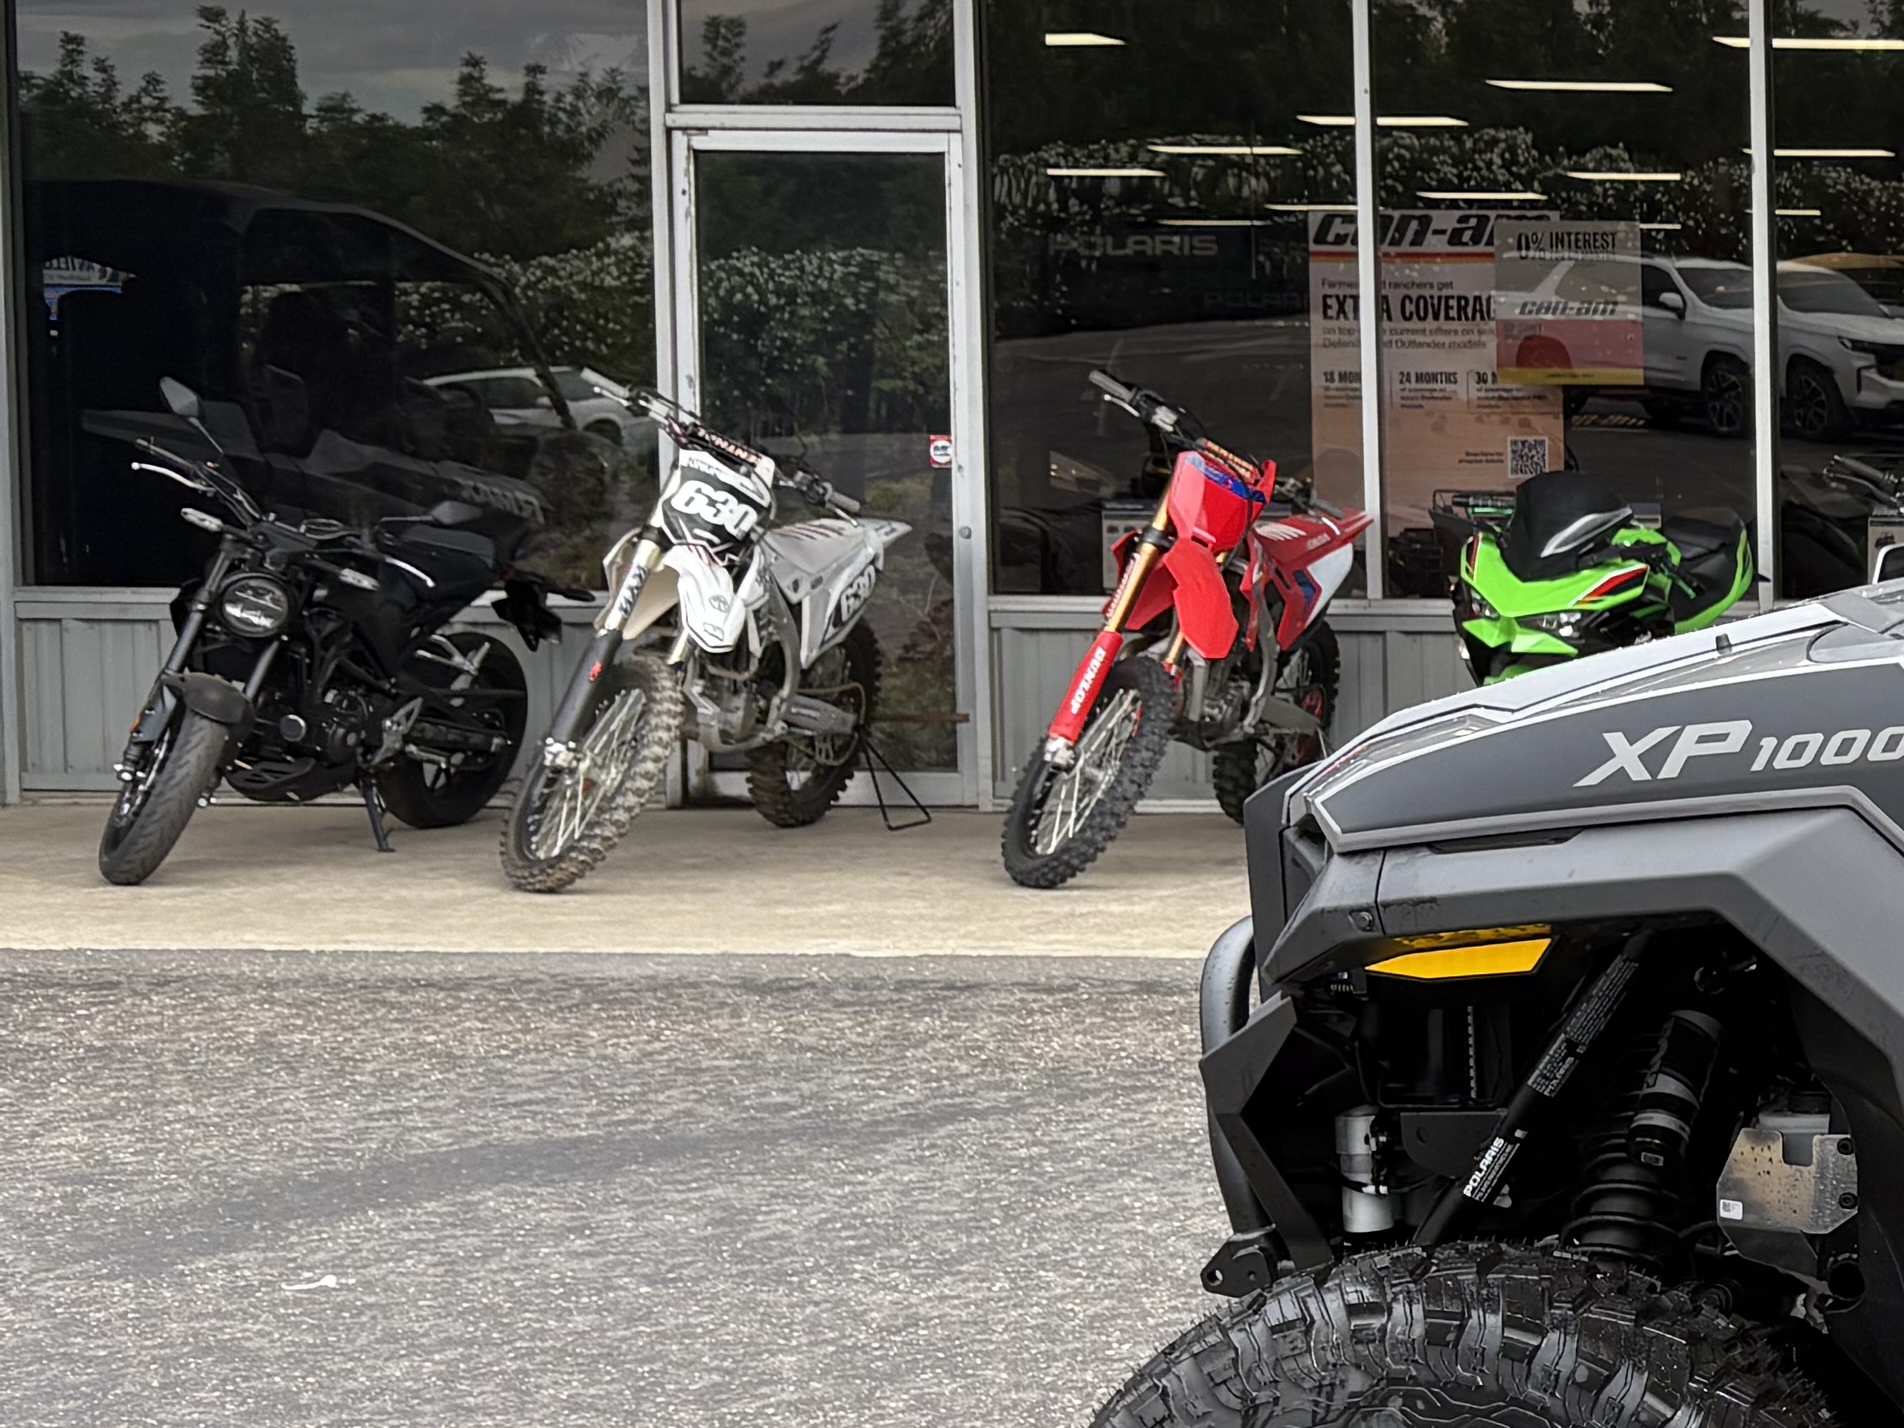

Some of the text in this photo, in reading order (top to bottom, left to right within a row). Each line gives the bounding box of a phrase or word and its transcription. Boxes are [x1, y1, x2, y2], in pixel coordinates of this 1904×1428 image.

[1050, 235, 1218, 256] POLARIS
[1550, 232, 1617, 249] INTEREST
[1322, 294, 1393, 321] EXTA
[670, 480, 758, 541] 630
[1071, 648, 1107, 714] DUNLOP
[1573, 719, 1752, 788] XP
[1463, 1137, 1504, 1197] POLARIS
